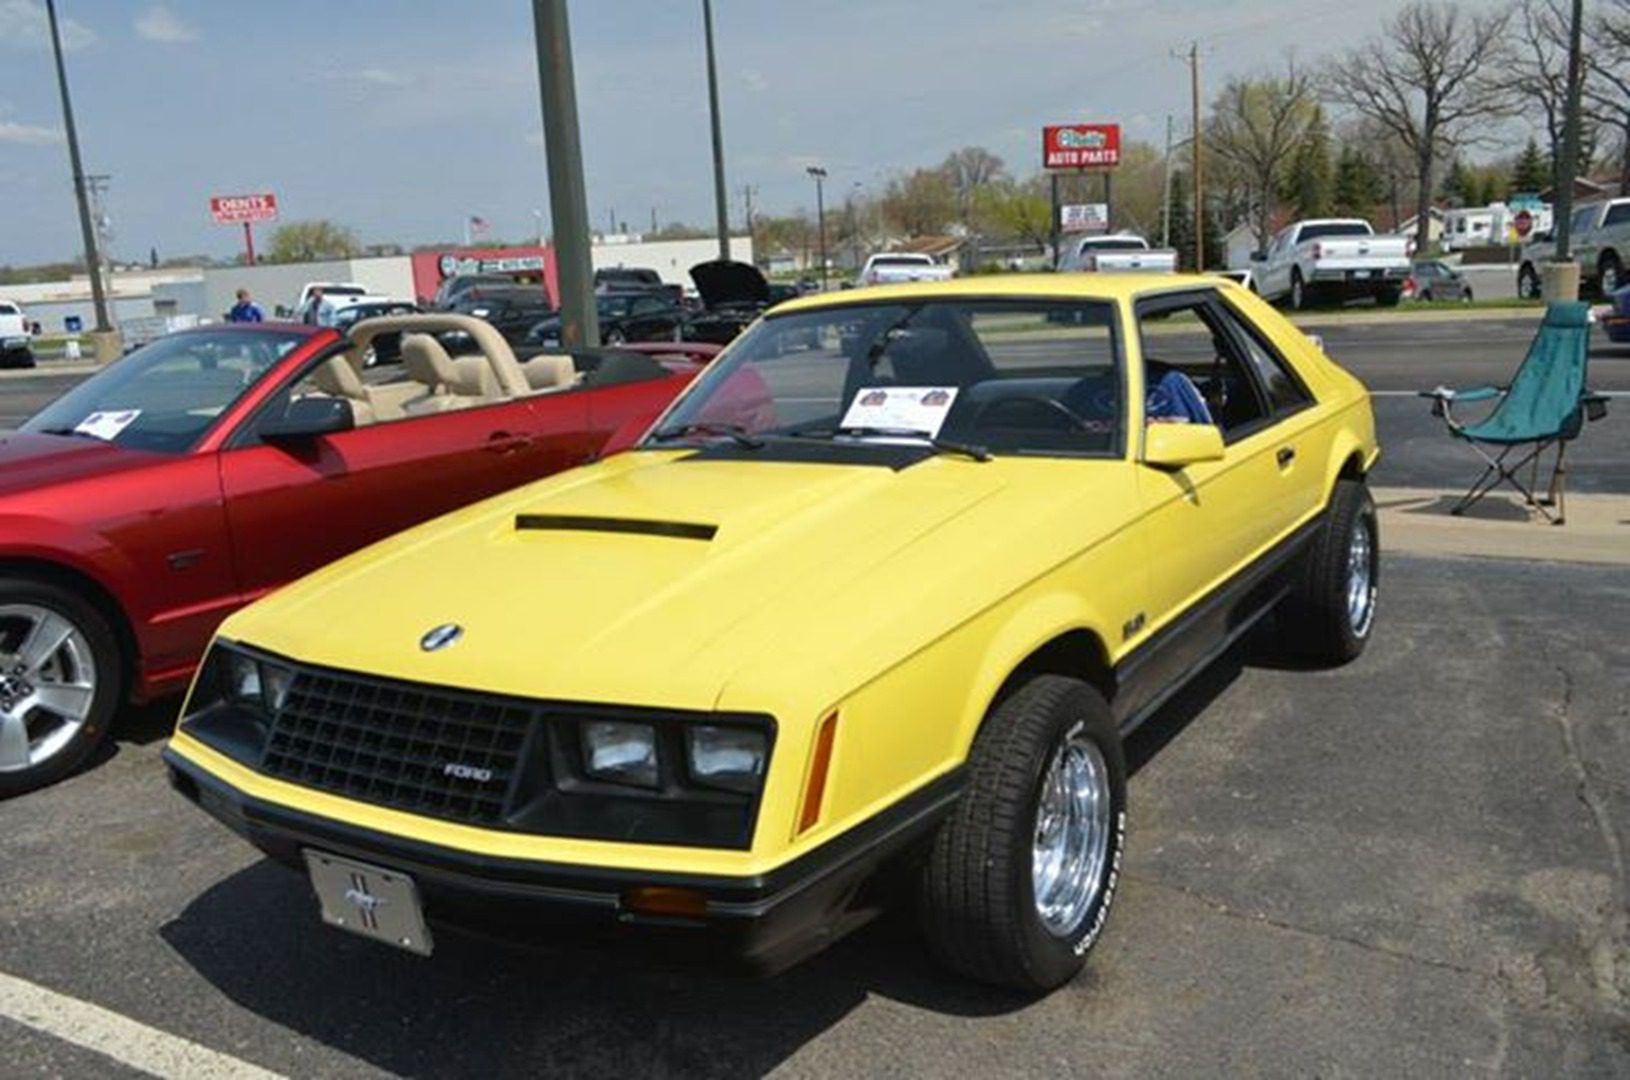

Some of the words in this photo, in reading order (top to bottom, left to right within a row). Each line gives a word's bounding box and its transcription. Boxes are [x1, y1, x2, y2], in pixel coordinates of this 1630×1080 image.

[1048, 152, 1078, 164] AUTO
[1081, 149, 1117, 164] PARTS
[444, 763, 491, 781] FORD
